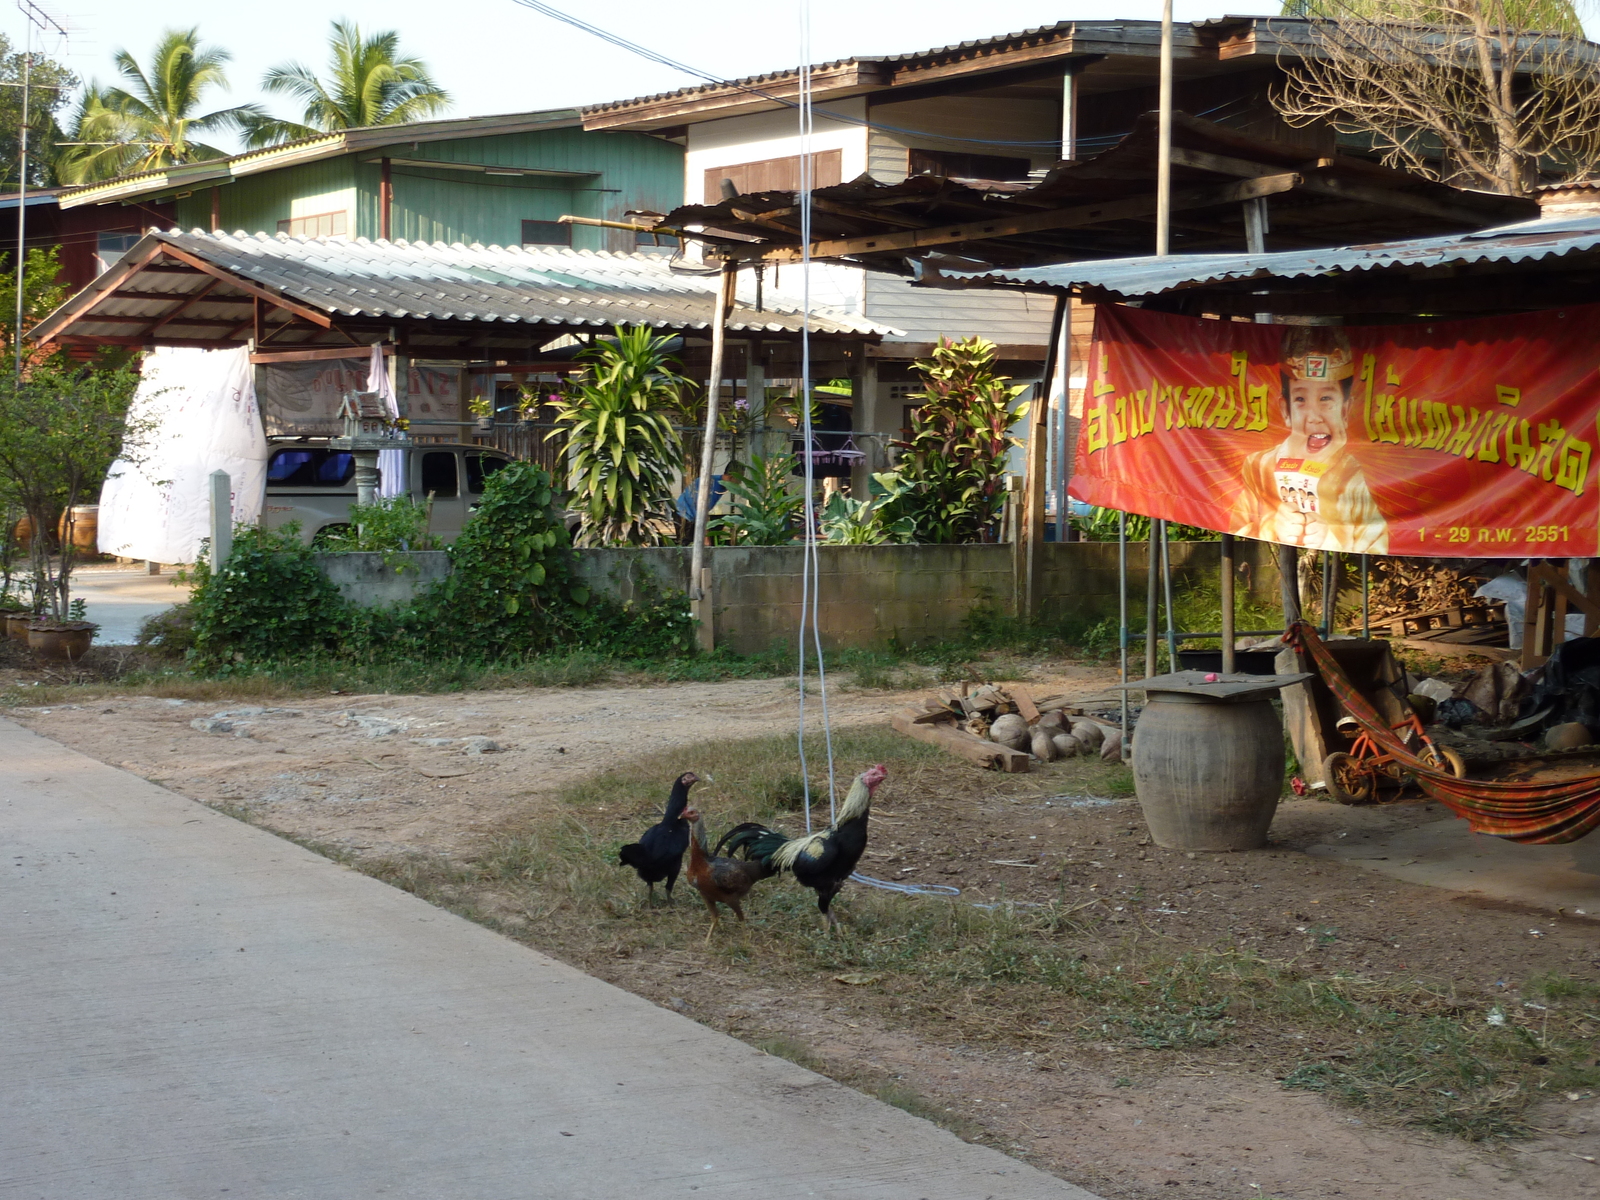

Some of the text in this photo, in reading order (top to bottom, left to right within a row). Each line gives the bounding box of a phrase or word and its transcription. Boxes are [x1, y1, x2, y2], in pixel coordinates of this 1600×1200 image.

[1087, 350, 1592, 497] อั่งเปาแทนใจ ใช้แทนเงินสด
[1417, 527, 1426, 542] 1
[1449, 527, 1471, 543] 29
[1478, 529, 1517, 543] ก.พ.
[1525, 526, 1569, 542] 2551
